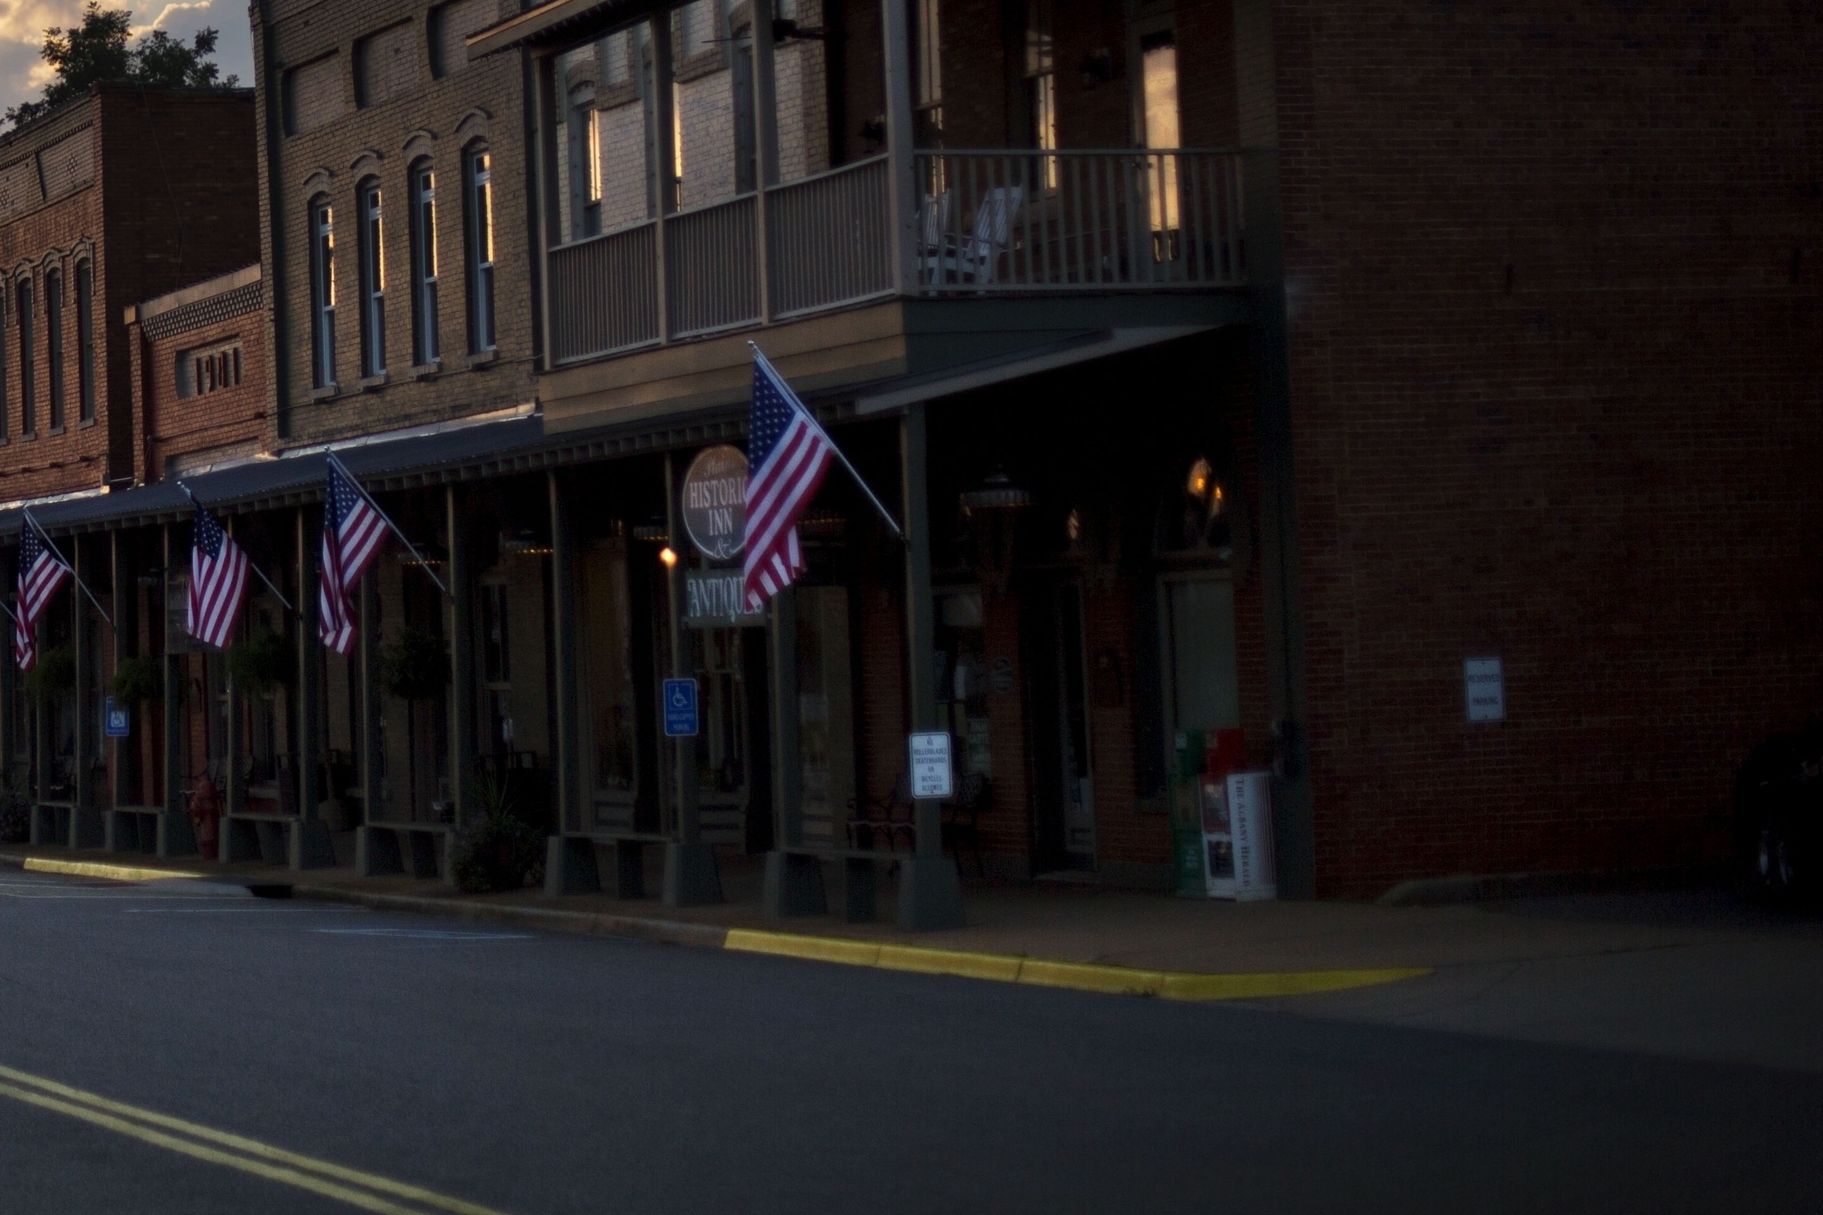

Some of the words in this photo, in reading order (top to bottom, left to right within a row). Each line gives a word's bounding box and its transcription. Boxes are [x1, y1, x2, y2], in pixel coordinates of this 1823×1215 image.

[689, 476, 747, 508] HISTORIC
[707, 508, 733, 536] INN
[714, 538, 732, 559] &
[688, 576, 763, 623] ANTIQU
[1468, 673, 1500, 683] RESERVED
[1472, 696, 1499, 706] PARKING
[1235, 778, 1245, 800] THE
[1241, 846, 1251, 887] HERALD
